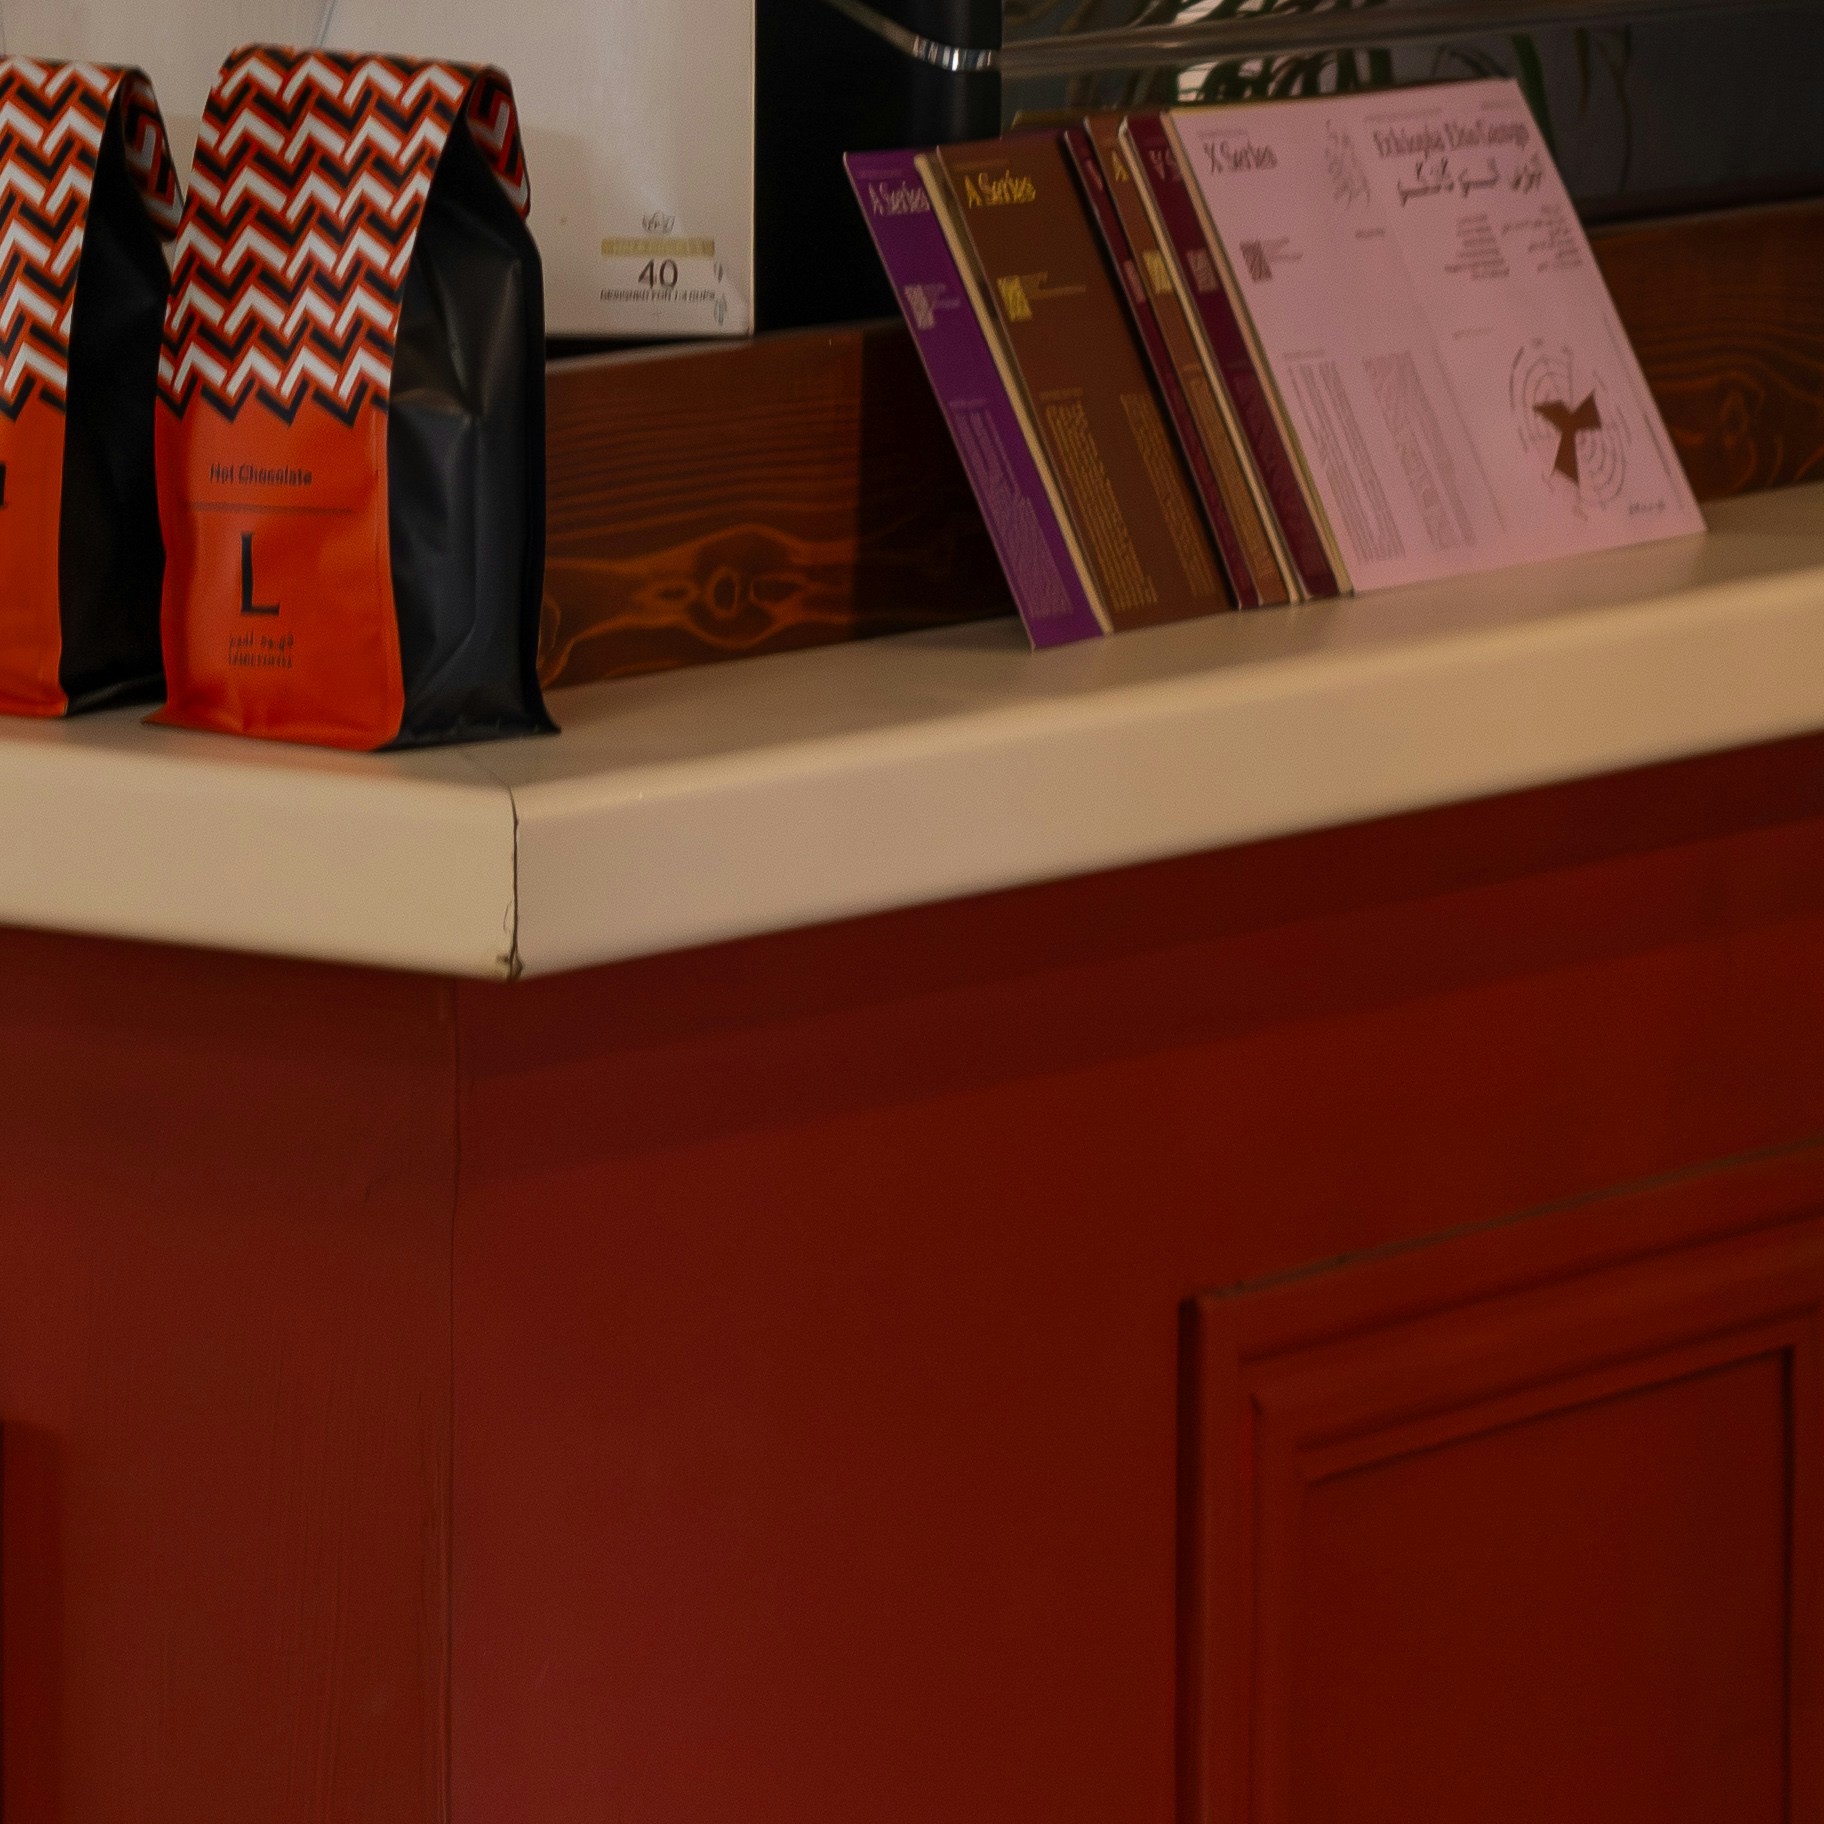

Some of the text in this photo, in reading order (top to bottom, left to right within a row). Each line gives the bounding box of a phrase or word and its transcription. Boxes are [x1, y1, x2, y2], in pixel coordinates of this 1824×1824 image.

[637, 257, 679, 289] 40
[209, 459, 312, 486] Hot Chocolate
[240, 530, 281, 617] L
